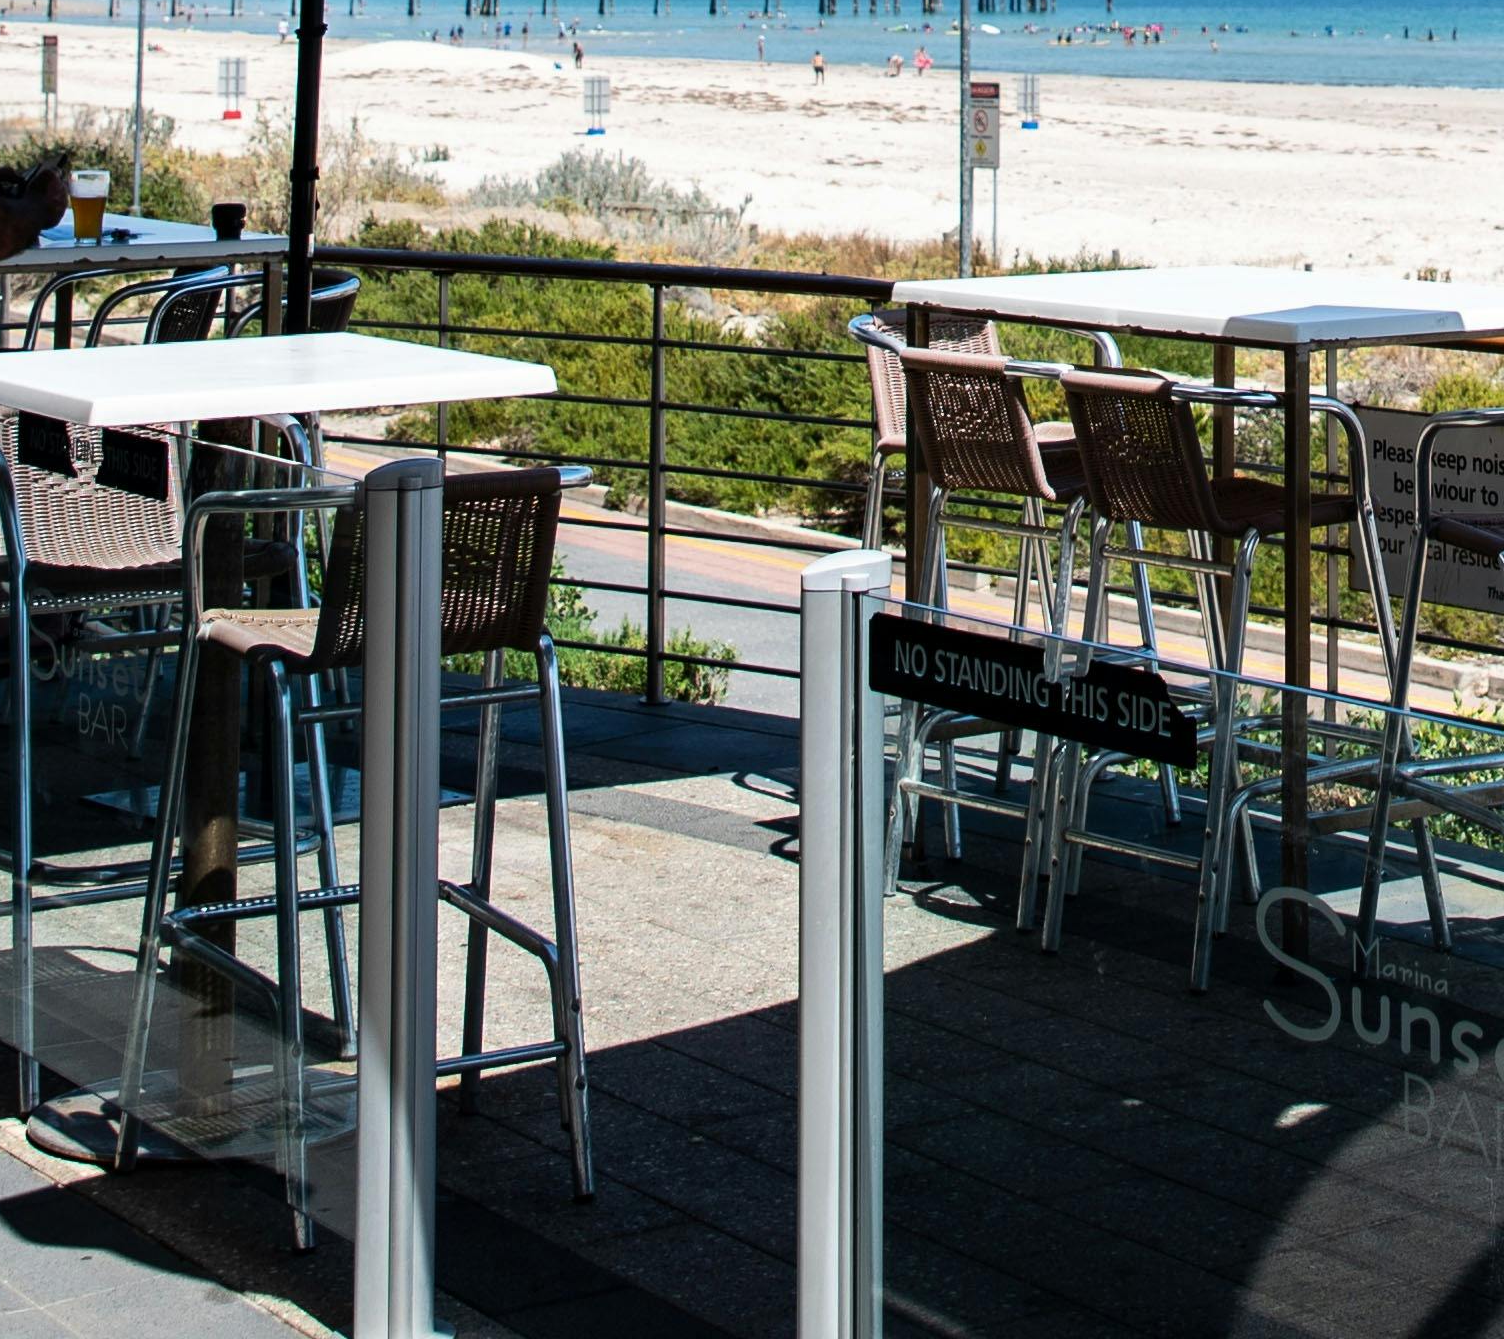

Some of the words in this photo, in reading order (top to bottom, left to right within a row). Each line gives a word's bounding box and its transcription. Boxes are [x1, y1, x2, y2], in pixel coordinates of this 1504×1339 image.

[106, 445, 130, 474] THIS
[133, 450, 158, 481] SIDE
[1373, 439, 1414, 464] Pleas
[1394, 472, 1476, 504] beviour
[1480, 485, 1499, 507] to
[895, 639, 927, 678] NO
[933, 648, 1050, 708] STANDING
[1057, 675, 1109, 723] THIS
[1116, 689, 1172, 737] SIDE
[79, 691, 128, 750] BAR
[1352, 931, 1449, 995] Marina
